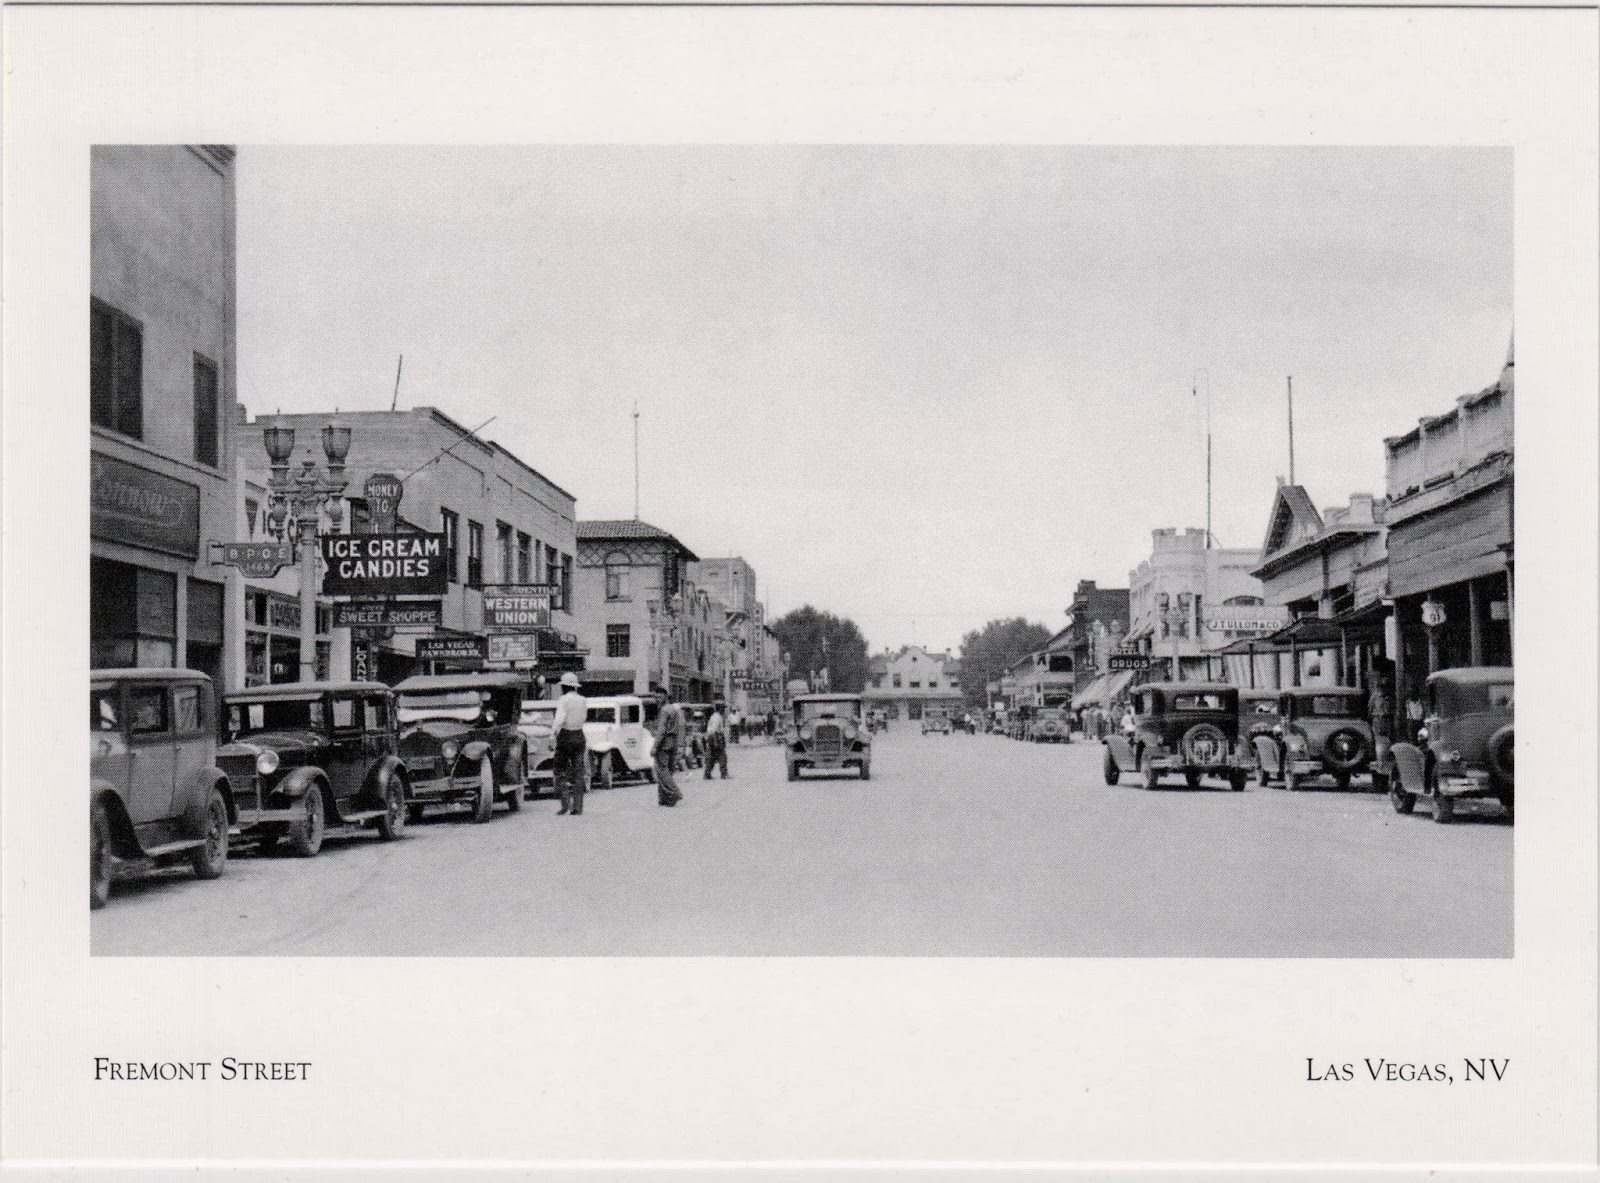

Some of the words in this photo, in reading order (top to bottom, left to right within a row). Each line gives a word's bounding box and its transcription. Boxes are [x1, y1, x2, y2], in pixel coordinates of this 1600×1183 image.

[367, 484, 399, 498] MONEY
[375, 498, 389, 514] TO
[328, 539, 361, 558] ICE
[368, 538, 440, 558] CREAM
[339, 559, 430, 579] CANDIES
[484, 597, 548, 611] WESTERN
[338, 610, 383, 624] SWEET
[388, 610, 437, 623] SHOPPE
[494, 611, 538, 624] UNION
[428, 641, 445, 649] LAS
[447, 640, 475, 649] VEGAS
[1111, 659, 1149, 669] DRUGS
